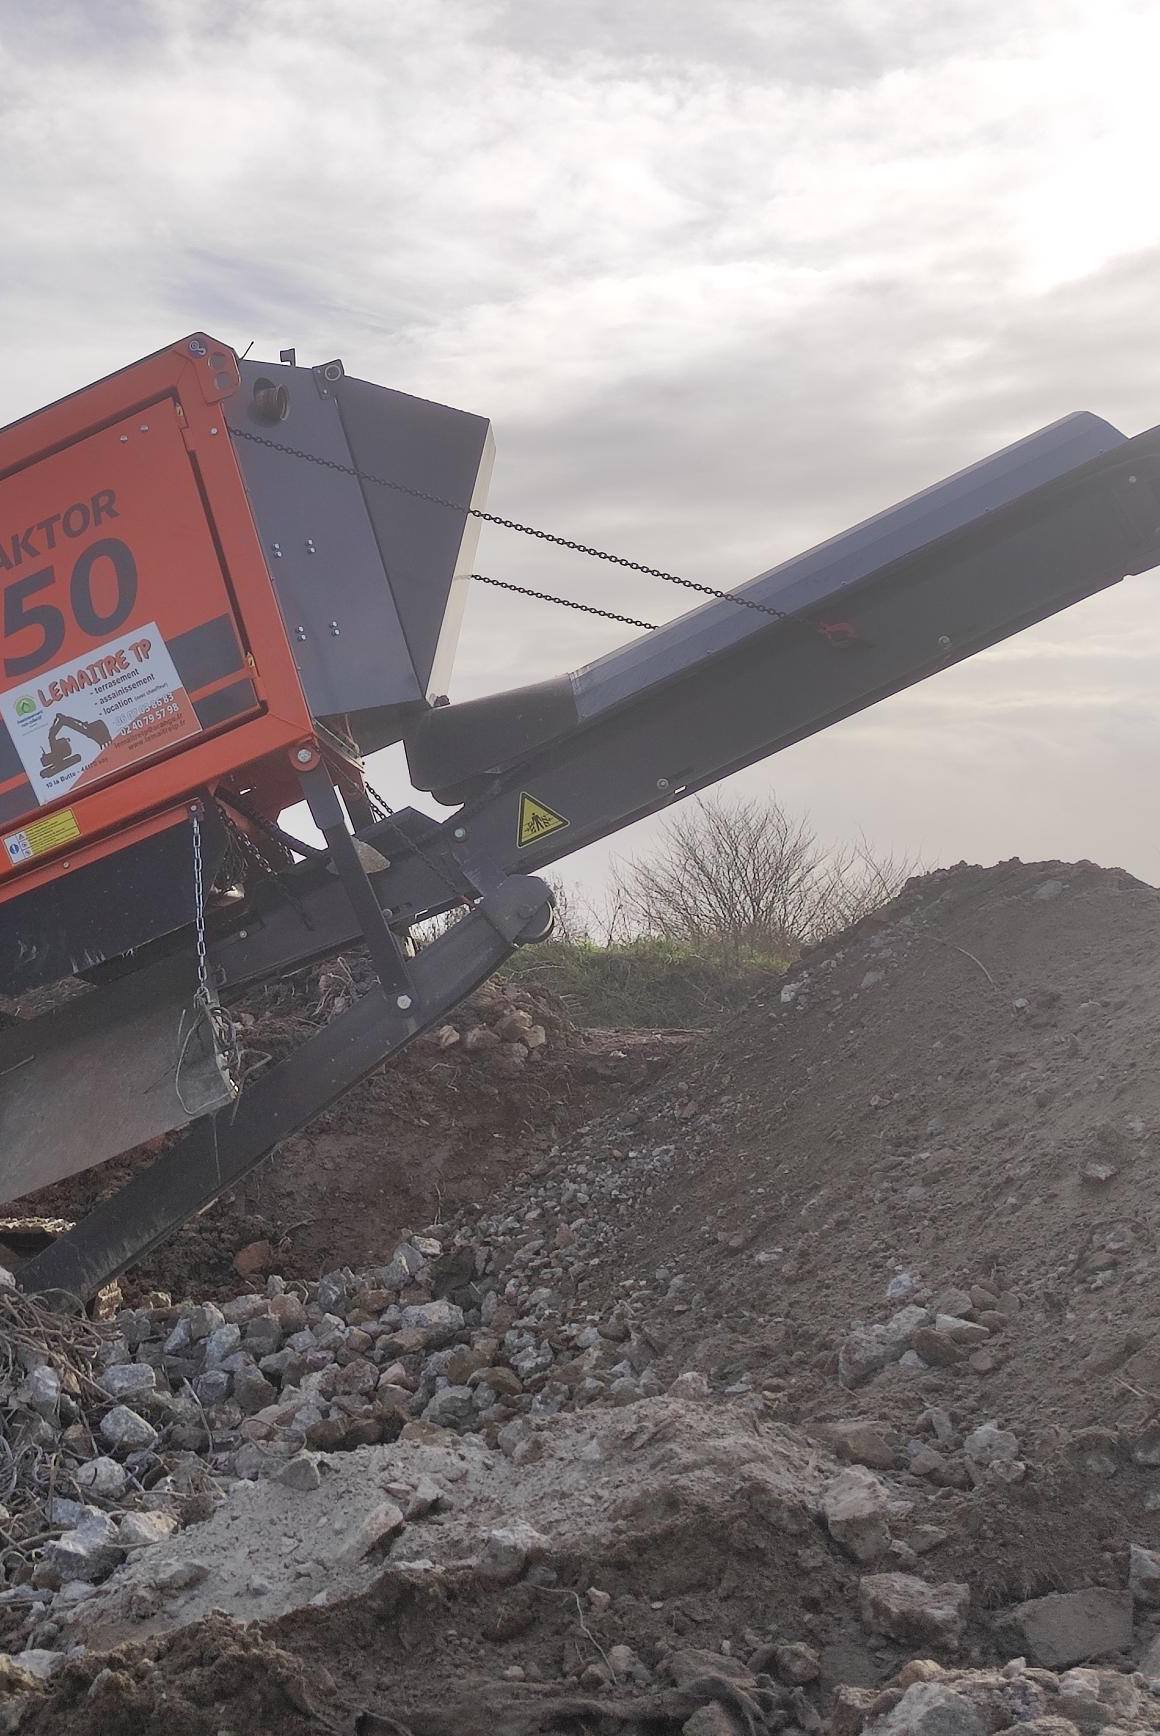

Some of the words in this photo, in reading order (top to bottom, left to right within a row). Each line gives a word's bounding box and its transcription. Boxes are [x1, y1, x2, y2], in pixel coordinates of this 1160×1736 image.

[37, 649, 130, 707] LEMAITRE
[128, 639, 151, 662] TP
[94, 668, 140, 695] terrasement
[99, 673, 155, 705] assainissement
[103, 696, 133, 716] location
[120, 726, 132, 736] 02
[132, 719, 144, 730] 40
[143, 714, 154, 725] 79
[155, 709, 166, 720] 57
[166, 703, 179, 714] 98
